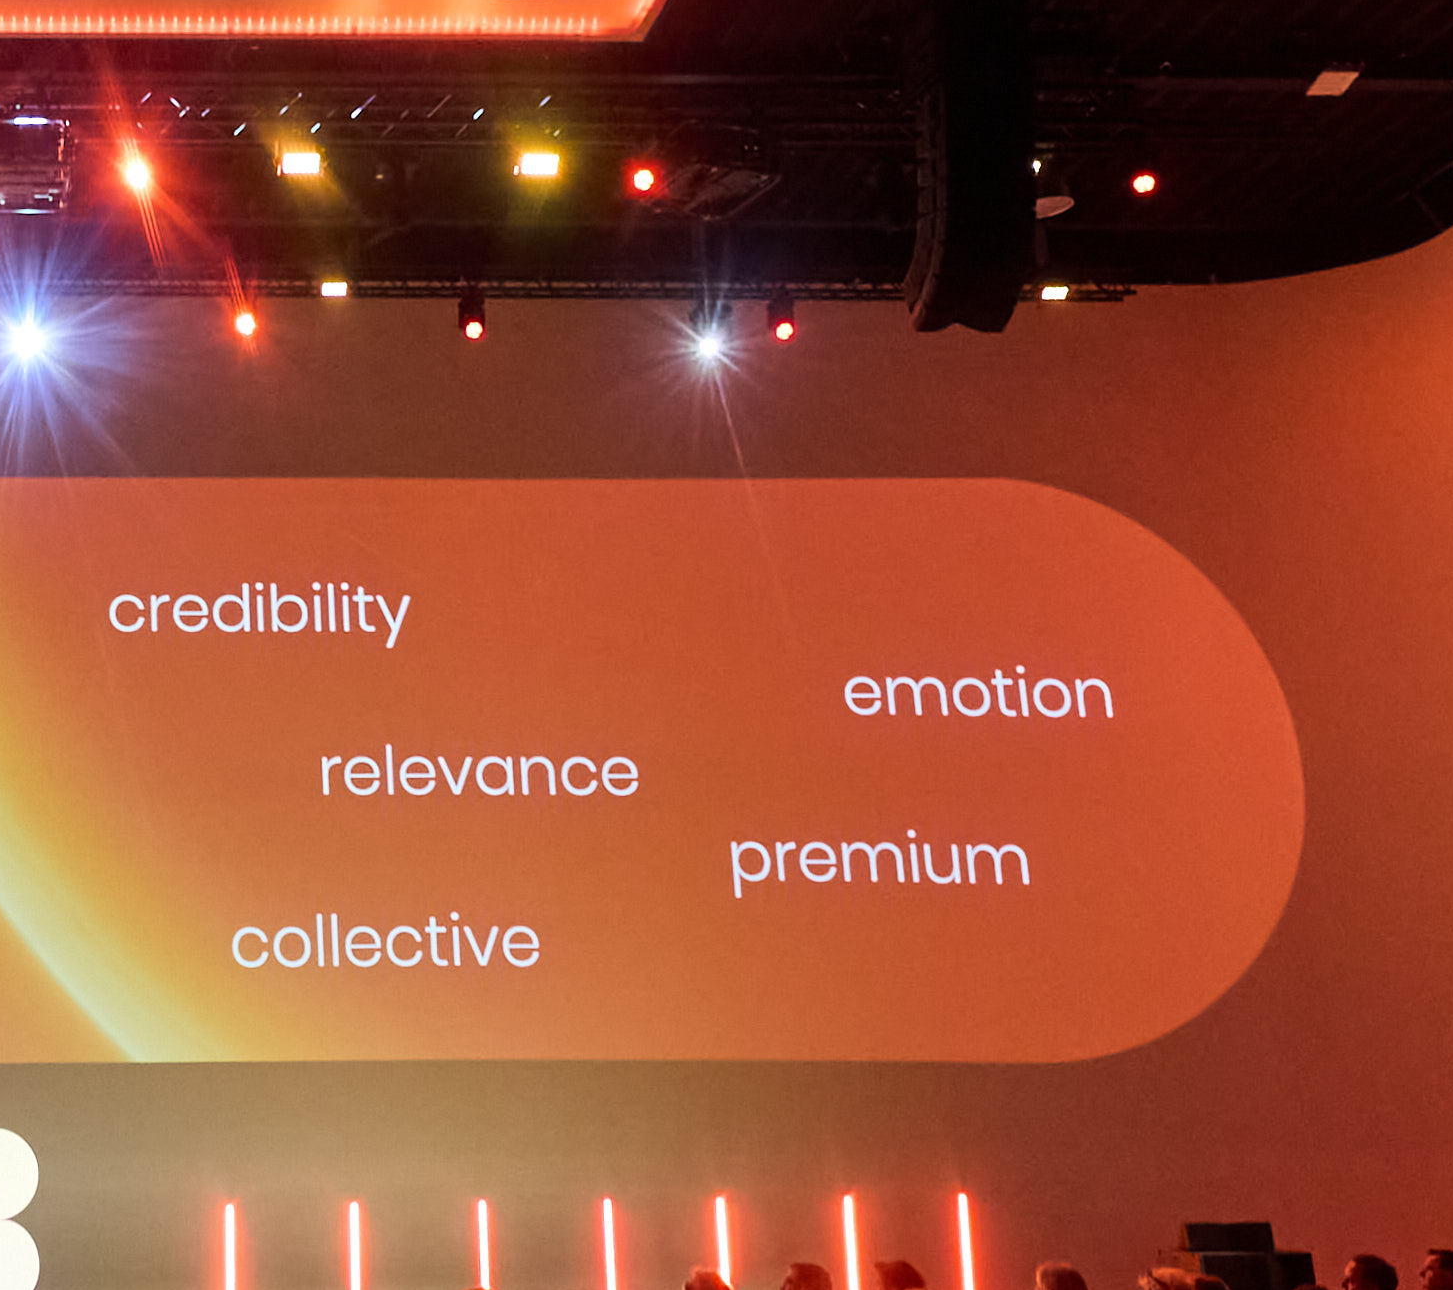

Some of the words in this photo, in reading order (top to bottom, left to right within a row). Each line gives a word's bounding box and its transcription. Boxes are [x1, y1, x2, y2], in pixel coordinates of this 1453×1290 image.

[108, 581, 411, 649] credibility
[844, 665, 1114, 718] emotion
[321, 743, 639, 797] relevance
[730, 829, 1030, 899] premium
[231, 911, 540, 969] collective
